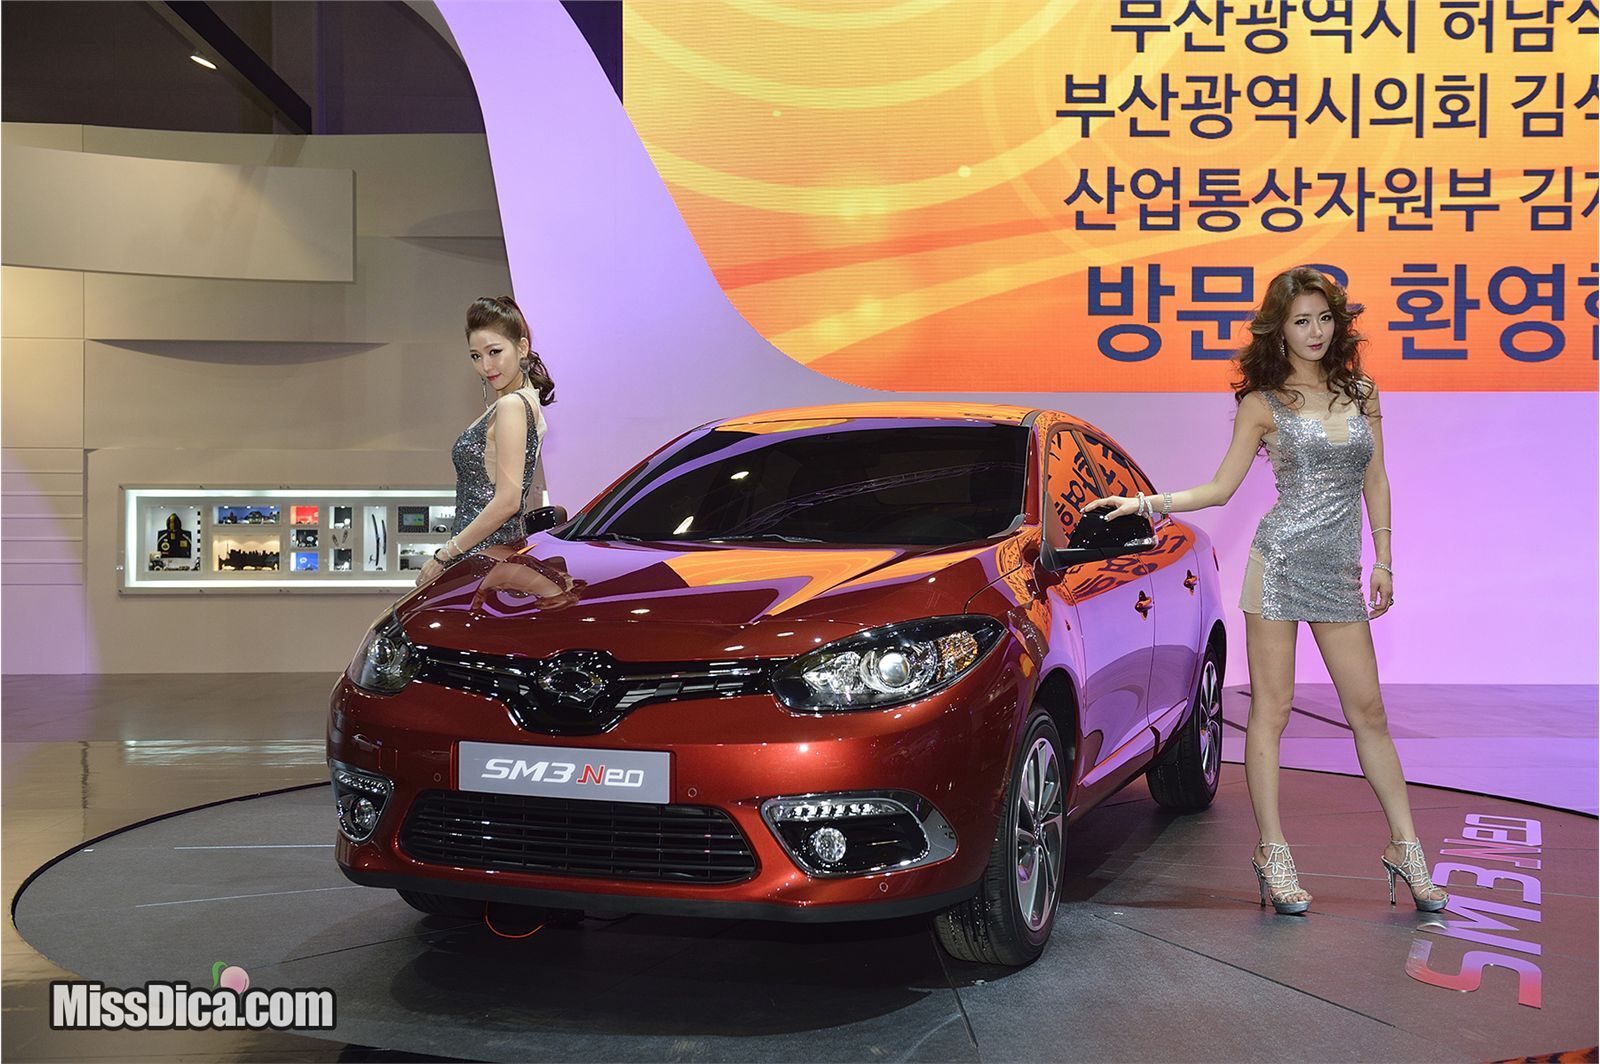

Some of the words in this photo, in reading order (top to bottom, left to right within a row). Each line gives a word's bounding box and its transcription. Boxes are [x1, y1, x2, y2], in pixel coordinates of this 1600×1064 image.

[1111, 0, 1416, 53] 부산광역시
[1056, 72, 1488, 139] 부산광역시의회
[1064, 166, 1500, 232] 산업통상자원부
[1088, 263, 1362, 362] 방문
[481, 758, 576, 784] SM3
[576, 764, 644, 788] Neo
